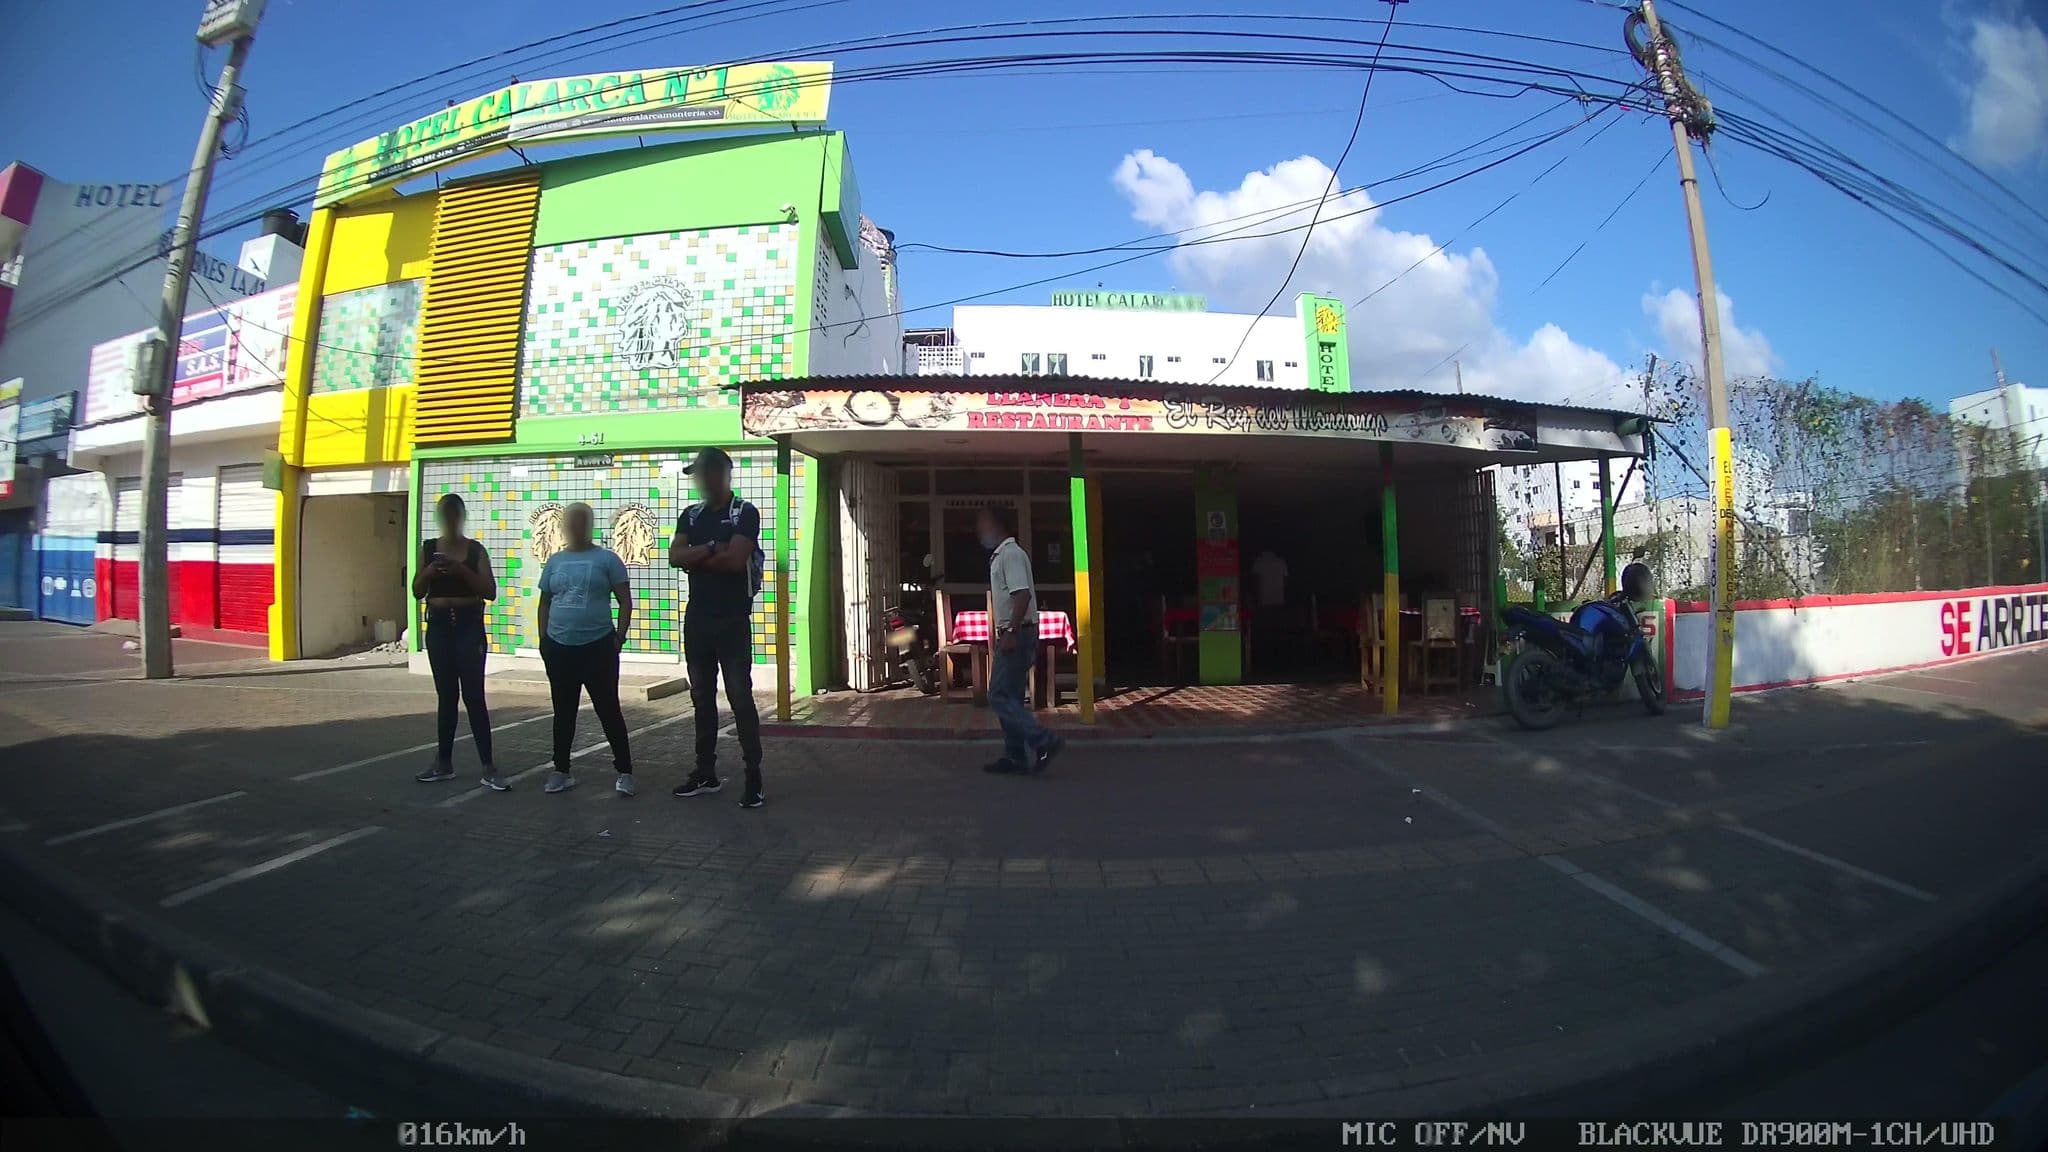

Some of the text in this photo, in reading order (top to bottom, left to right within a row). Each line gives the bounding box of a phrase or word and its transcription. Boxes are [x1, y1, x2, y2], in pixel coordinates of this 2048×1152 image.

[371, 106, 463, 166] HOTEL
[471, 72, 648, 130] CALARCA
[75, 183, 162, 208] HOTEL
[967, 411, 1154, 431] RESTAURANTE
[1941, 600, 1970, 656] SE
